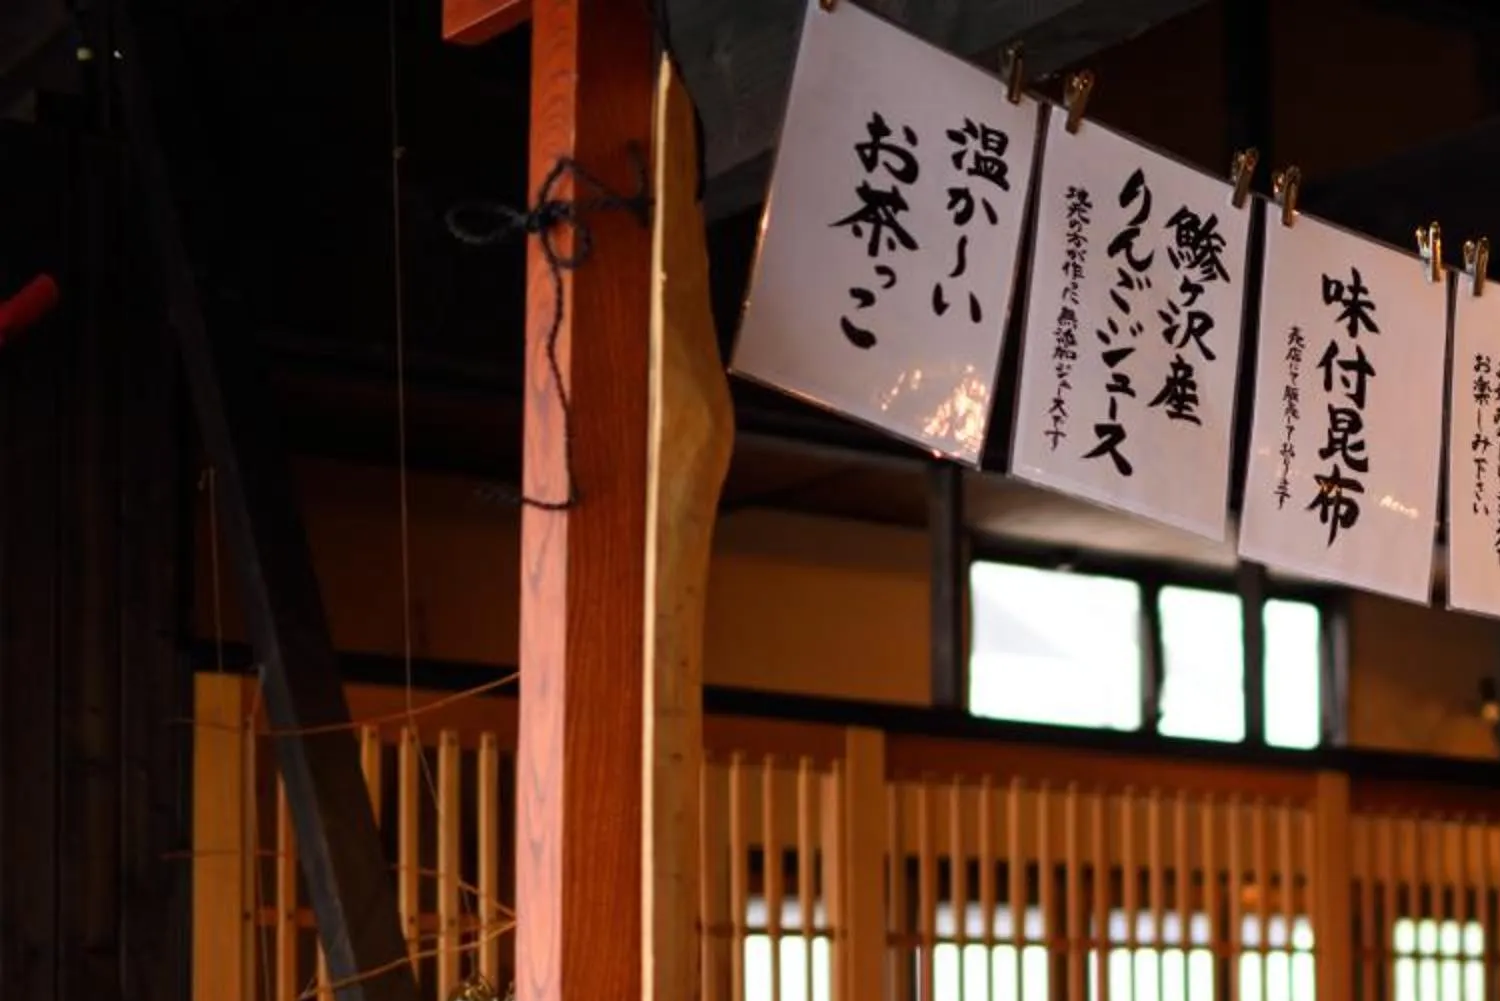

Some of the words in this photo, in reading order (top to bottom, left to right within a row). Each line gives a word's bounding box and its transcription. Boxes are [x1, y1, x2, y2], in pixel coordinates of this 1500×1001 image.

[828, 111, 920, 350] お茶っこ
[1080, 167, 1153, 477] りんごジュース
[1304, 266, 1381, 548] 味付昆布
